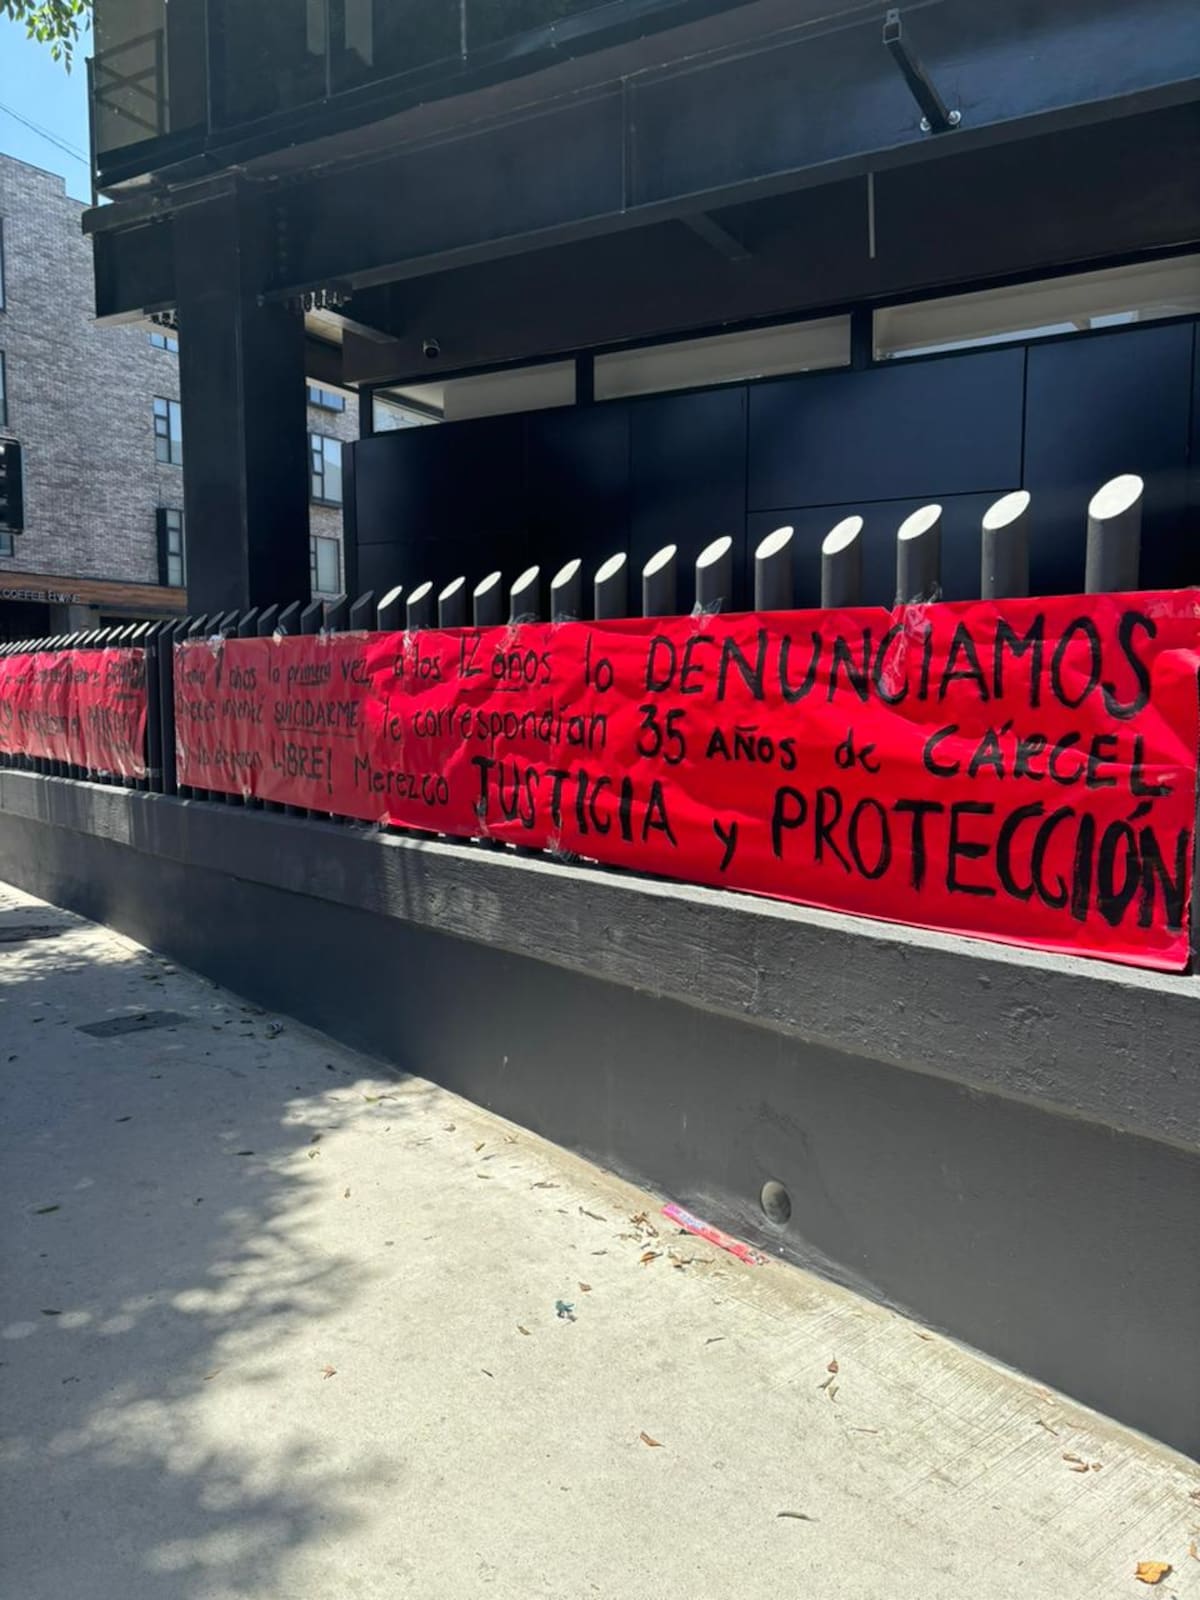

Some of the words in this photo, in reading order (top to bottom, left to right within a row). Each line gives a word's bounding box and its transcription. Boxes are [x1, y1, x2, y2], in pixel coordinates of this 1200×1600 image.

[414, 640, 441, 681] los
[459, 632, 483, 678] 12
[491, 643, 551, 684] años
[584, 632, 614, 693] lo
[645, 611, 1157, 720] DENUNCIAMOS
[413, 697, 607, 758] correspondían
[636, 703, 687, 766] 35
[834, 727, 881, 774] de
[922, 720, 1174, 797] CÁRCEL
[354, 752, 449, 806] Merezco
[471, 756, 678, 848] JUSTICIA
[771, 786, 1189, 934] PROTECCIÓN
